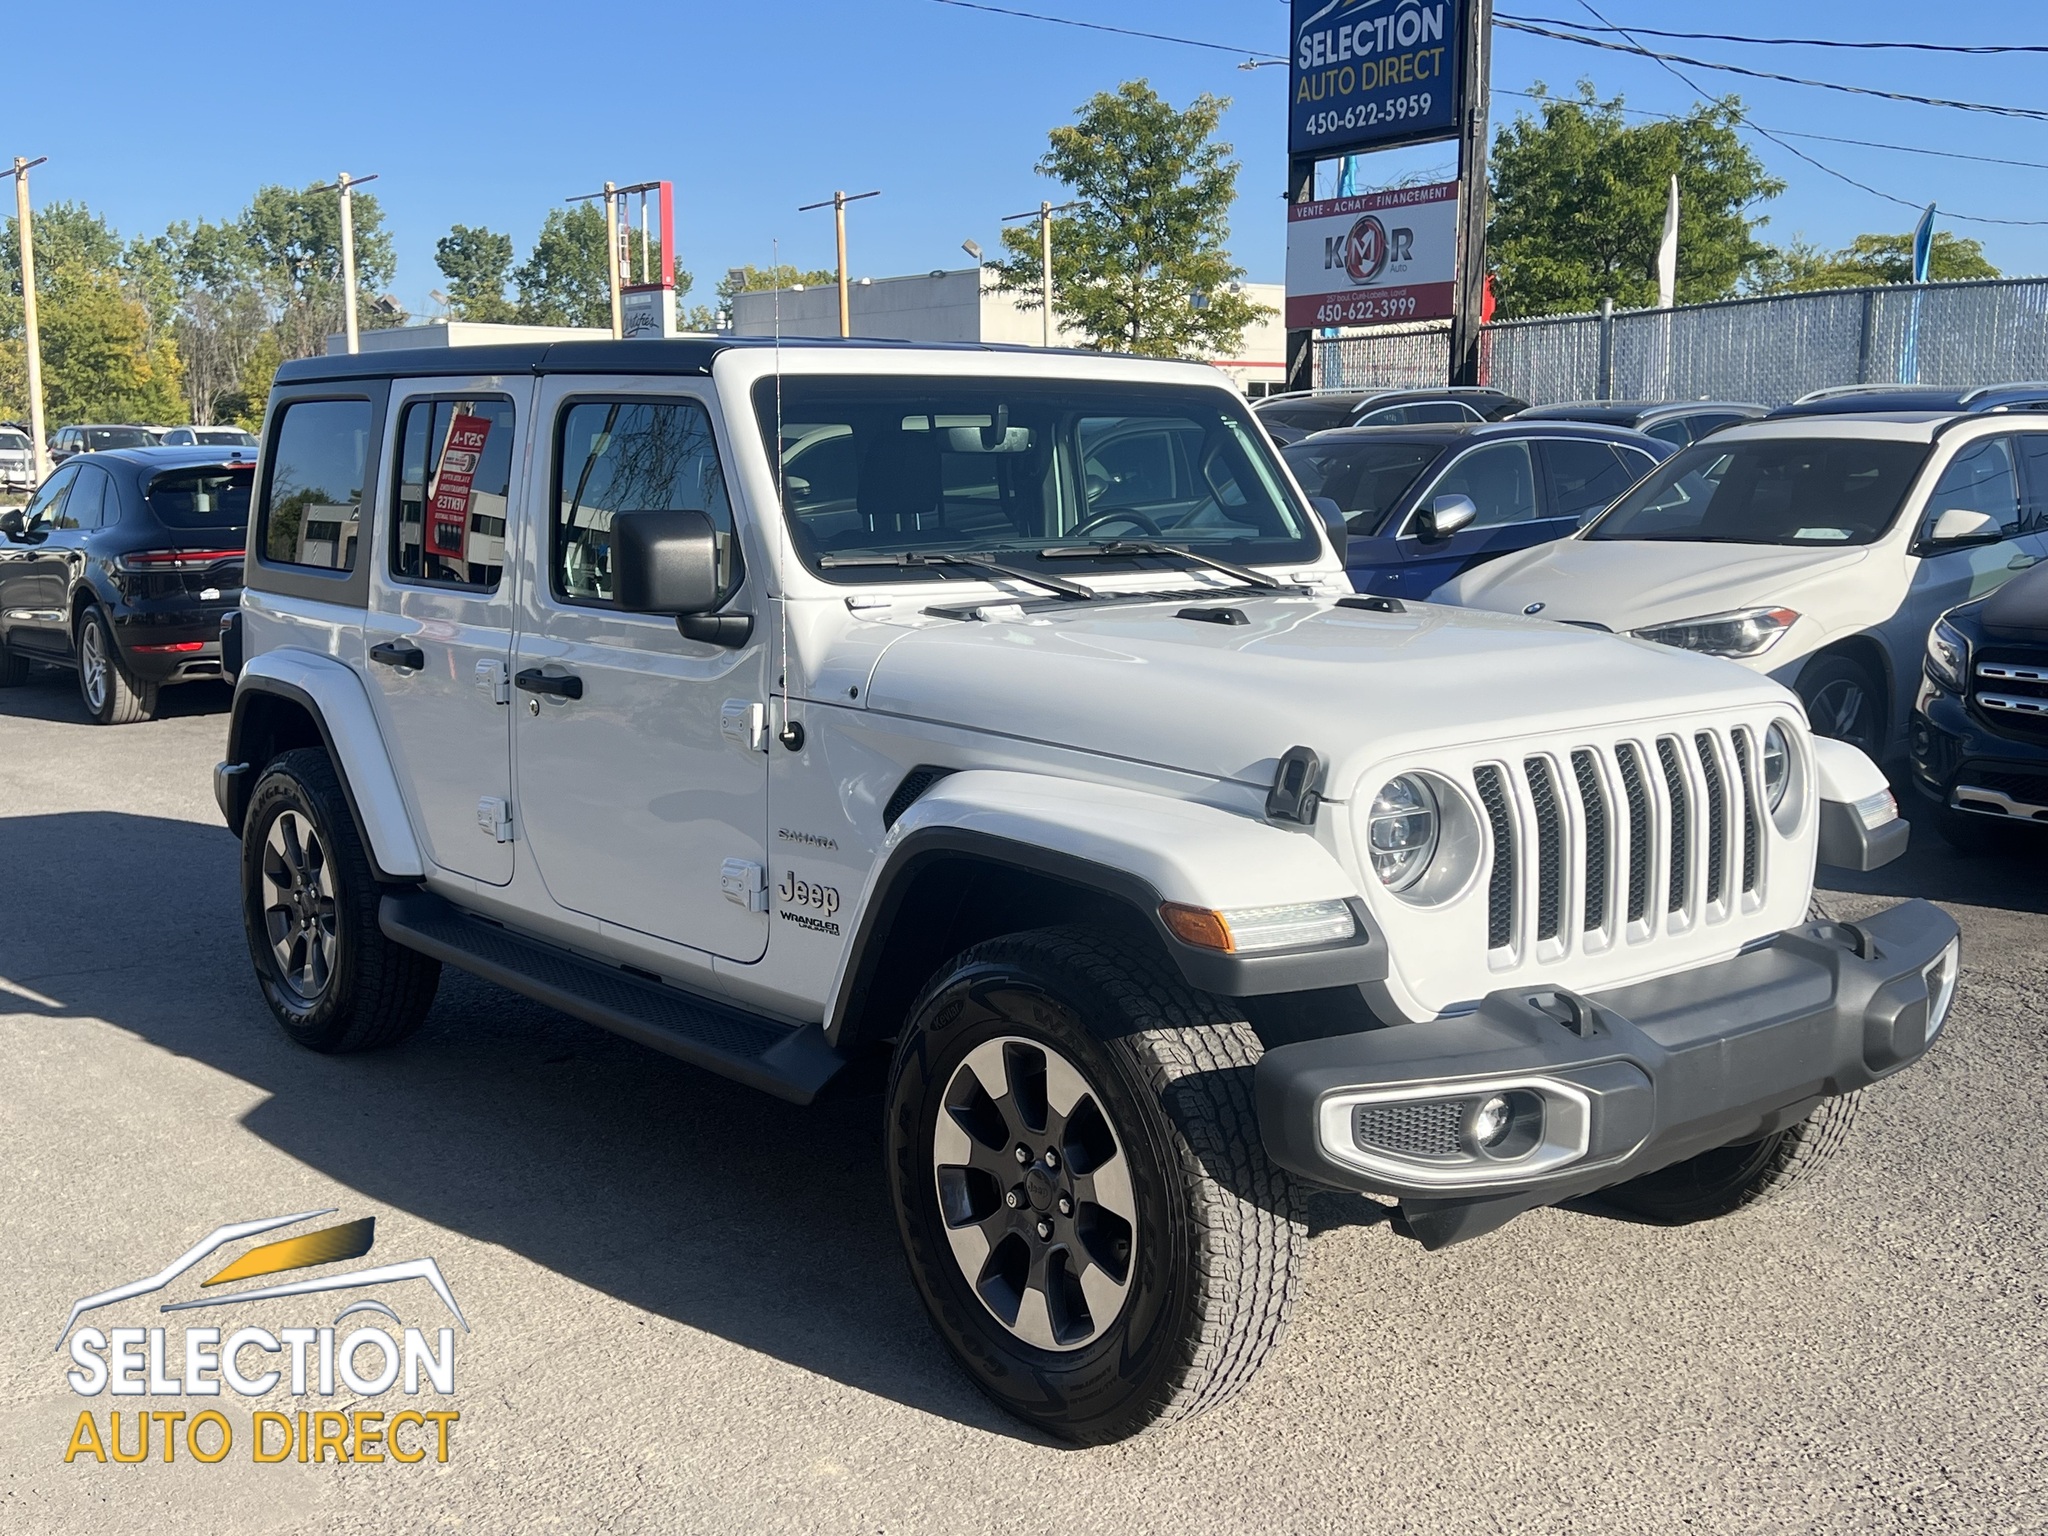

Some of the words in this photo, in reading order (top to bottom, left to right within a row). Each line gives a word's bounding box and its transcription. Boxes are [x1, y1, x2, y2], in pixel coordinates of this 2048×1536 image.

[1299, 4, 1444, 69] SELECTION
[1296, 67, 1355, 104] AUTO
[1362, 47, 1445, 91] DIRECT
[1306, 92, 1432, 135] 450-622-5959
[1296, 205, 1323, 217] VENTE
[1334, 199, 1367, 213] ACHAT
[1377, 187, 1448, 205] FINANCEMENT
[1317, 297, 1416, 322] 450-622-3999
[779, 828, 839, 851] SAHARA
[778, 870, 840, 917] Jeep
[780, 910, 839, 932] WRANGLER
[799, 923, 840, 936] UNLIMITED
[933, 1003, 961, 1030] Kevlar
